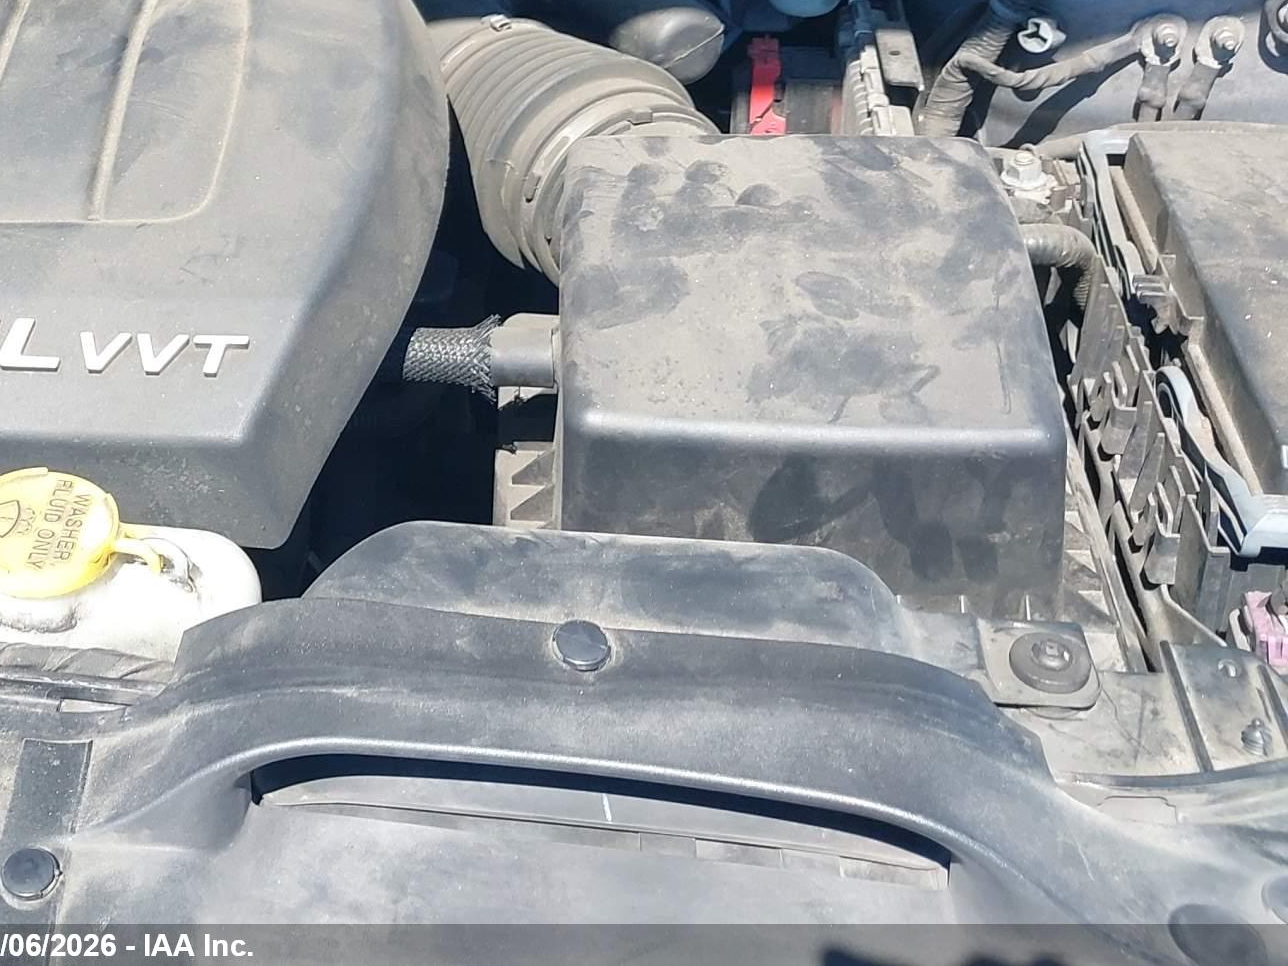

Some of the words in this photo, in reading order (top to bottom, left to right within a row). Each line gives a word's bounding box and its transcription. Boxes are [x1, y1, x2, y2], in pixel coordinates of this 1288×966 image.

[79, 330, 251, 377] VVT
[43, 479, 73, 523] FLUID
[26, 528, 55, 569] ONLY
[52, 493, 91, 562] WASHER
